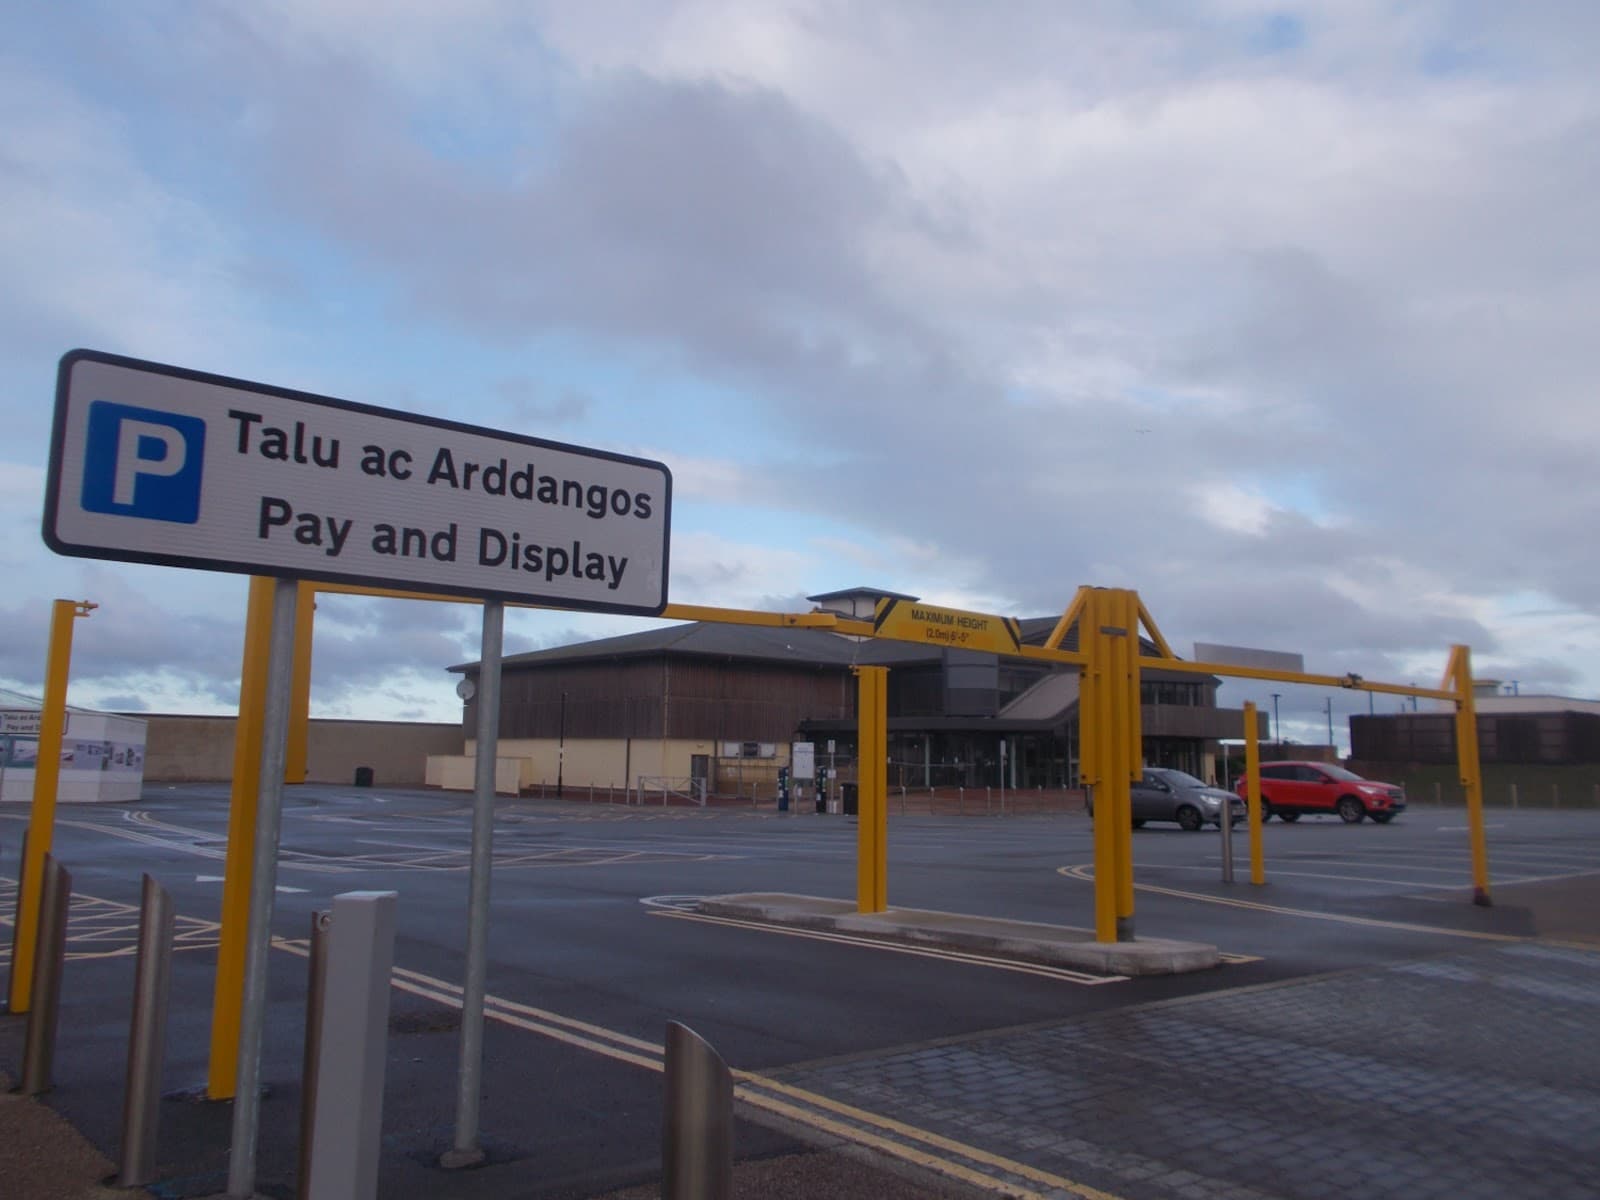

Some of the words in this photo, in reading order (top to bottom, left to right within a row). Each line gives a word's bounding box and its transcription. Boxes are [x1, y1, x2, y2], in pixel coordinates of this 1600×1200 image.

[112, 418, 187, 505] P
[228, 409, 340, 470] Talu
[360, 445, 413, 480] ac
[427, 448, 652, 519] Arddangos
[258, 496, 355, 557] Pay
[371, 523, 458, 563] and
[477, 527, 629, 590] Display
[911, 609, 954, 625] MAXIMUM
[957, 616, 988, 631] HEIGHT
